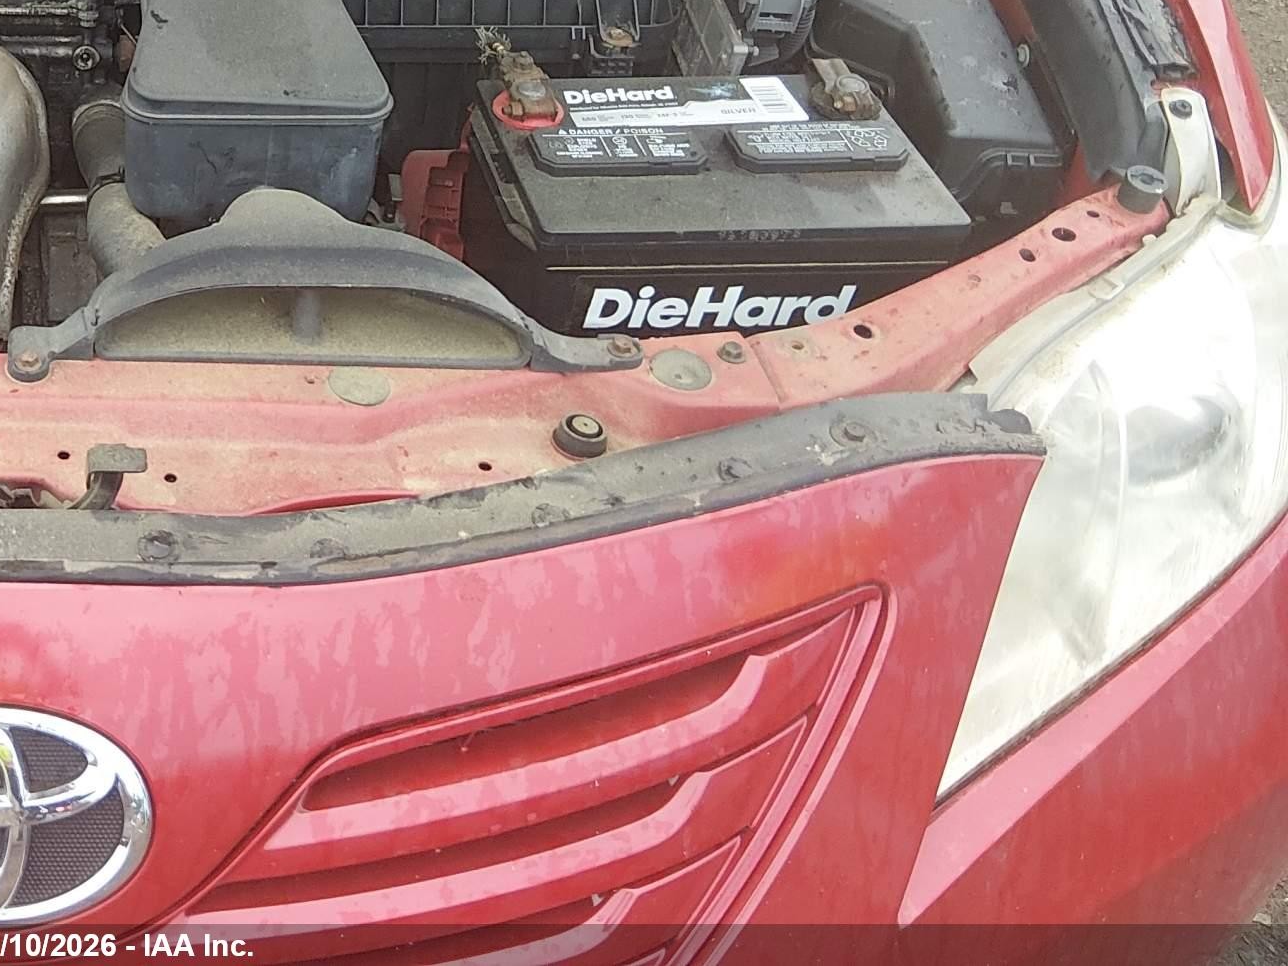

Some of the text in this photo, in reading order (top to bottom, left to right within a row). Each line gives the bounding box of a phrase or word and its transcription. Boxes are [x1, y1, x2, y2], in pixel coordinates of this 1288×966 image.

[563, 86, 674, 104] DieHard
[721, 107, 756, 115] SILVER
[582, 285, 857, 329] DieHard
